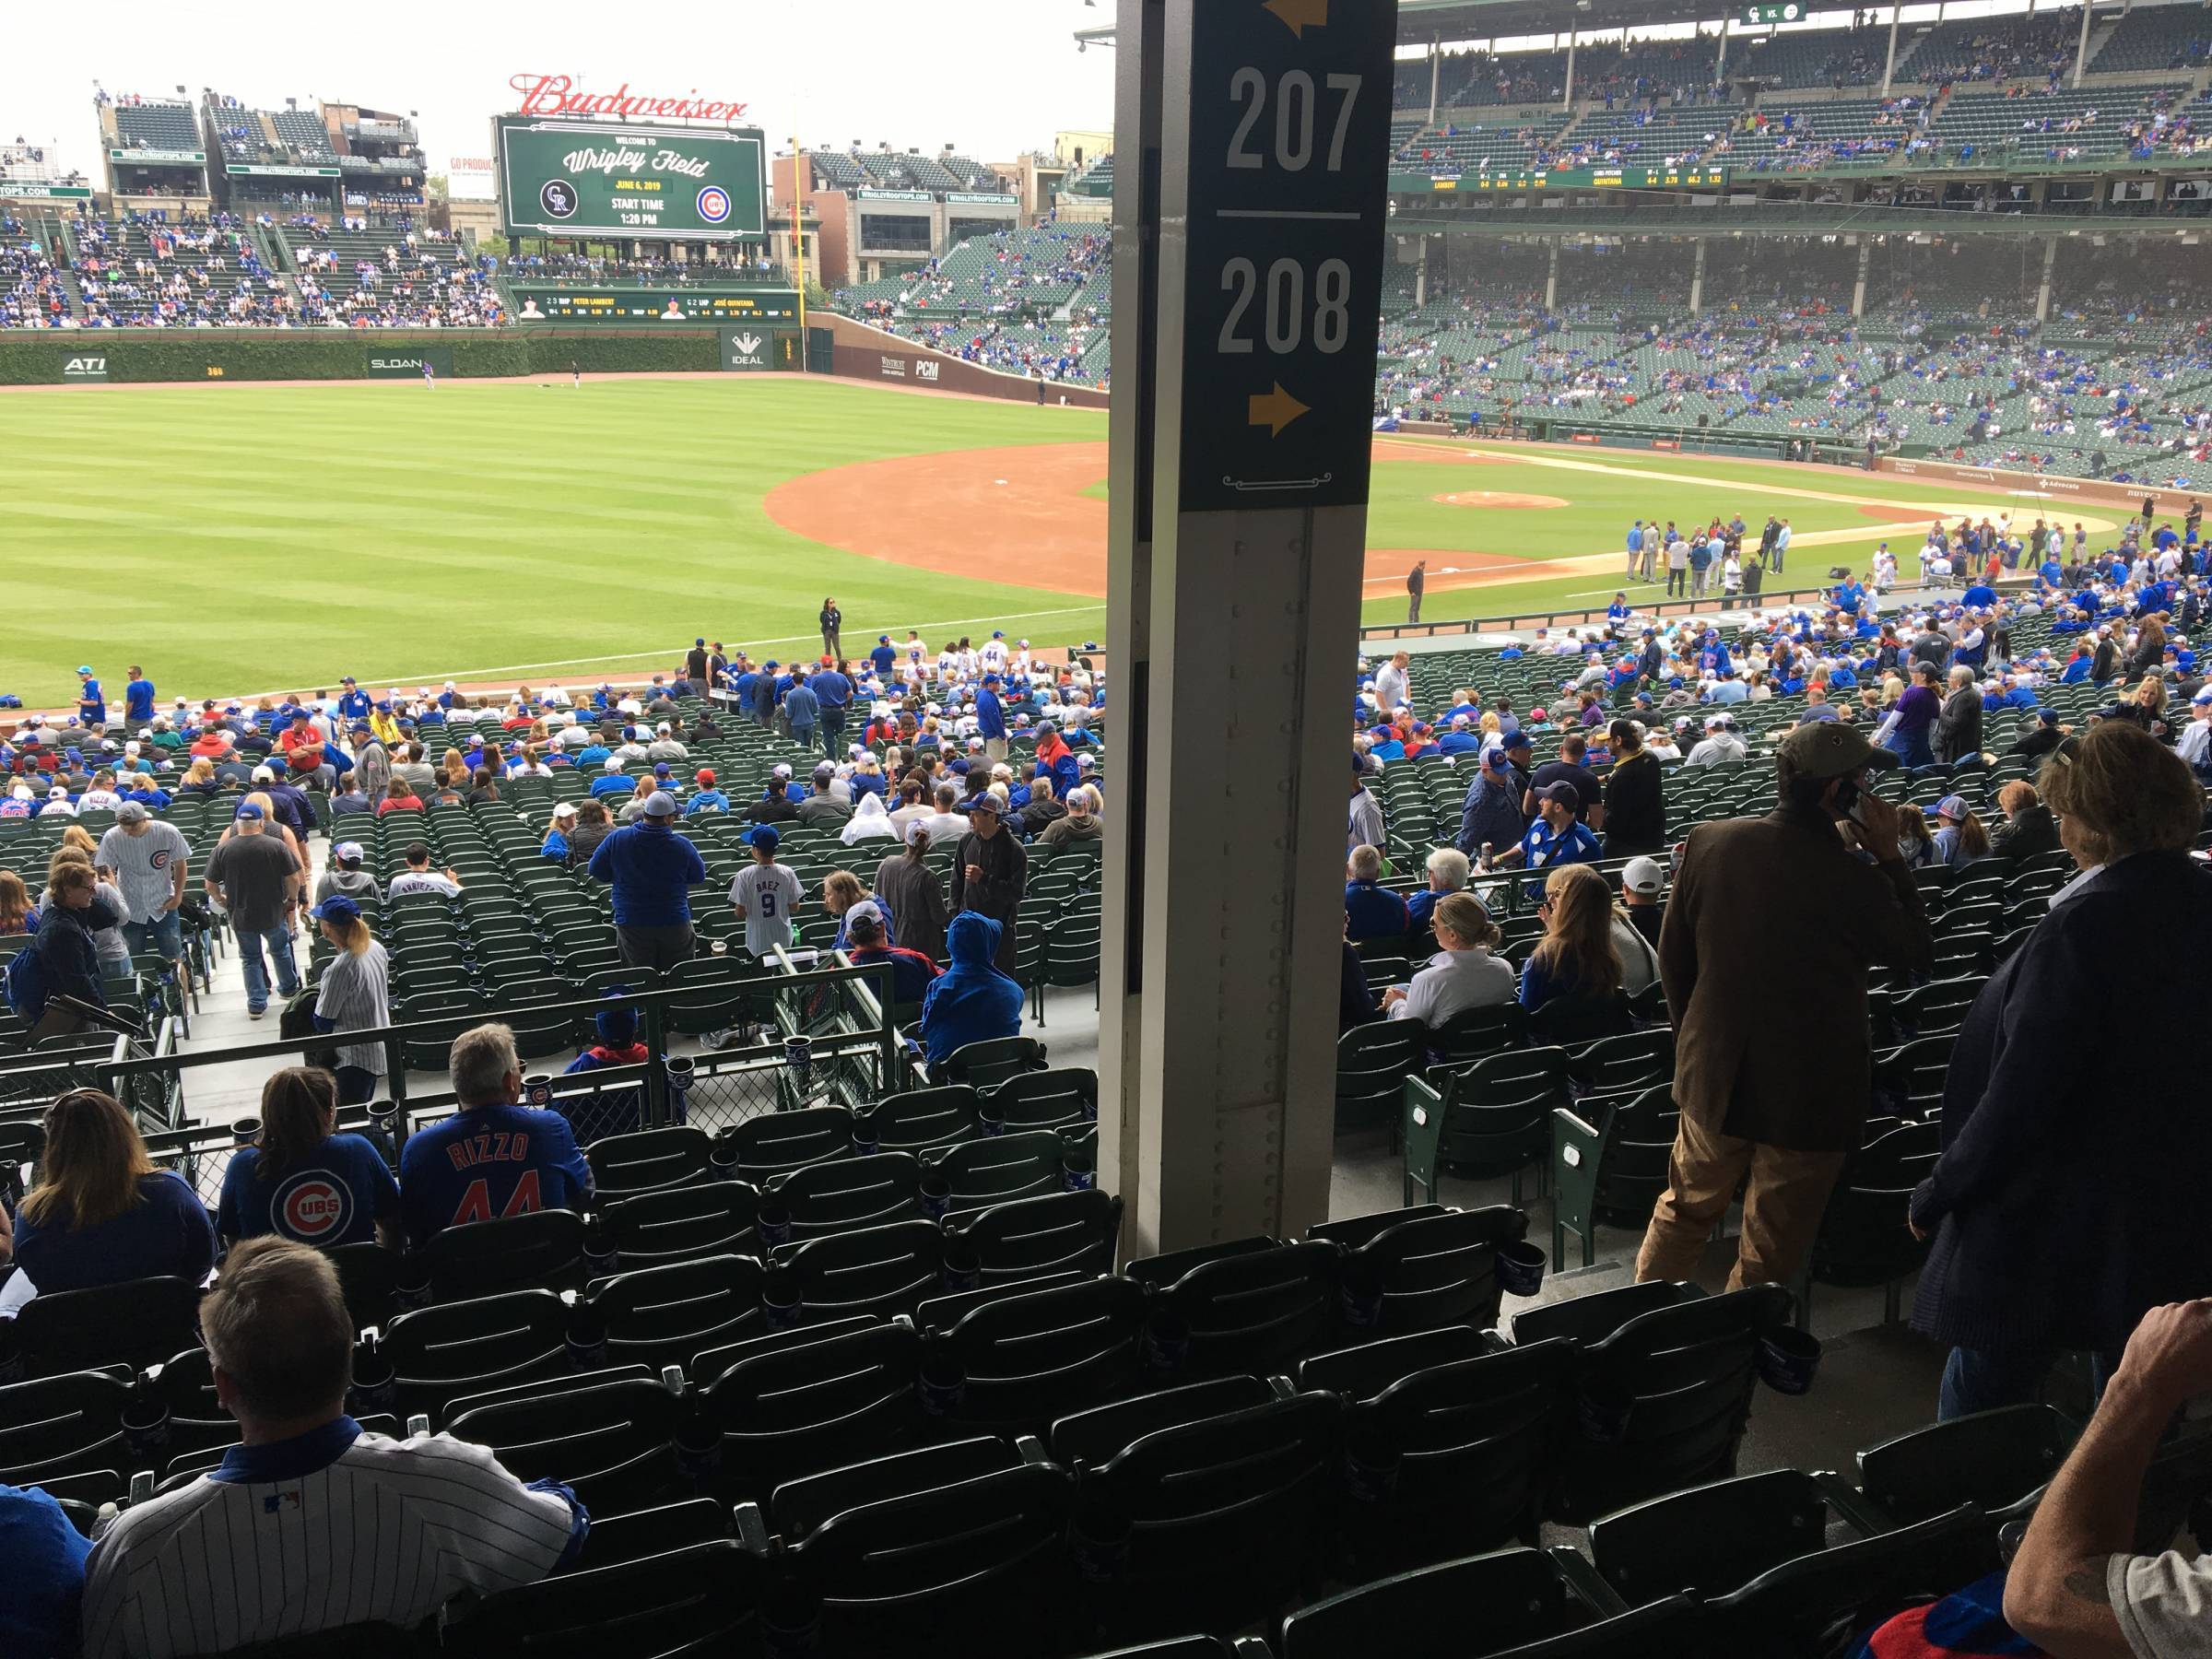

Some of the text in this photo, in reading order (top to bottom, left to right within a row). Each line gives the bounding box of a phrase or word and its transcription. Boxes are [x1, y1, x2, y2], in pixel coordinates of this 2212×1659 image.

[509, 73, 748, 121] Budweiser
[1226, 66, 1362, 171] 207
[615, 136, 656, 146] WELCOME TO
[562, 147, 711, 178] Wrigley Field
[615, 180, 661, 191] JUNE 6, 2019
[1434, 181, 1456, 189] LAMBERT
[1593, 177, 1622, 185] QUINTANA
[861, 191, 929, 201] WRIGLEYROOFTOPS.COM
[949, 194, 1016, 204] WRIGLEYROOFTOPS.COM
[611, 198, 665, 210] START TIME
[620, 214, 657, 225] 1:20 PM
[1218, 257, 1351, 355] 208
[64, 358, 106, 371] ATI
[371, 359, 422, 369] SLOAN
[732, 356, 764, 365] IDEAL
[915, 359, 939, 378] PCM
[2049, 480, 2080, 490] Advocate
[986, 651, 997, 662] 44
[756, 880, 781, 893] BAEZ
[761, 893, 776, 918] 9
[446, 1133, 529, 1171] RIZZO
[450, 1169, 542, 1226] 44
